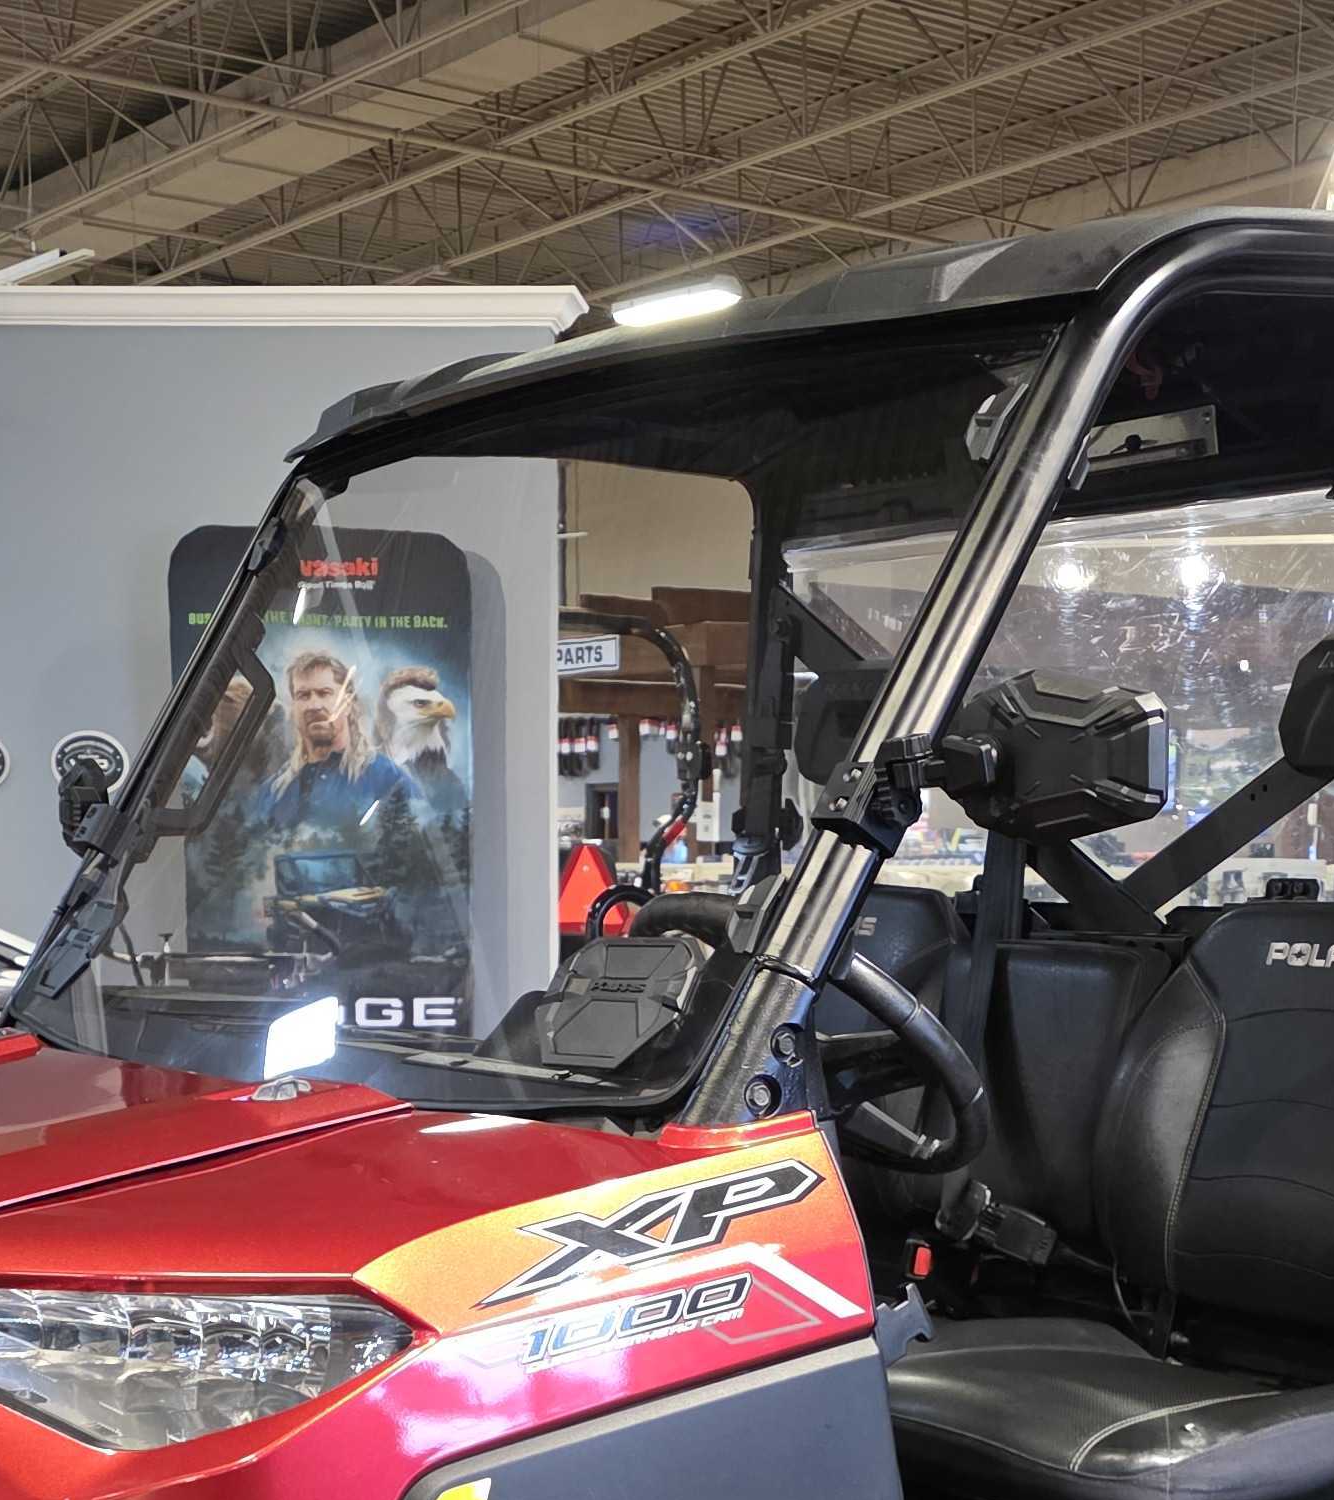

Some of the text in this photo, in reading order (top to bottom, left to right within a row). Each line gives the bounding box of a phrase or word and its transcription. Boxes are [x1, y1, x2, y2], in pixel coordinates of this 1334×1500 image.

[375, 615, 387, 628] IN
[390, 615, 411, 628] THE
[470, 1158, 826, 1310] XP
[521, 1271, 754, 1366] 1000
